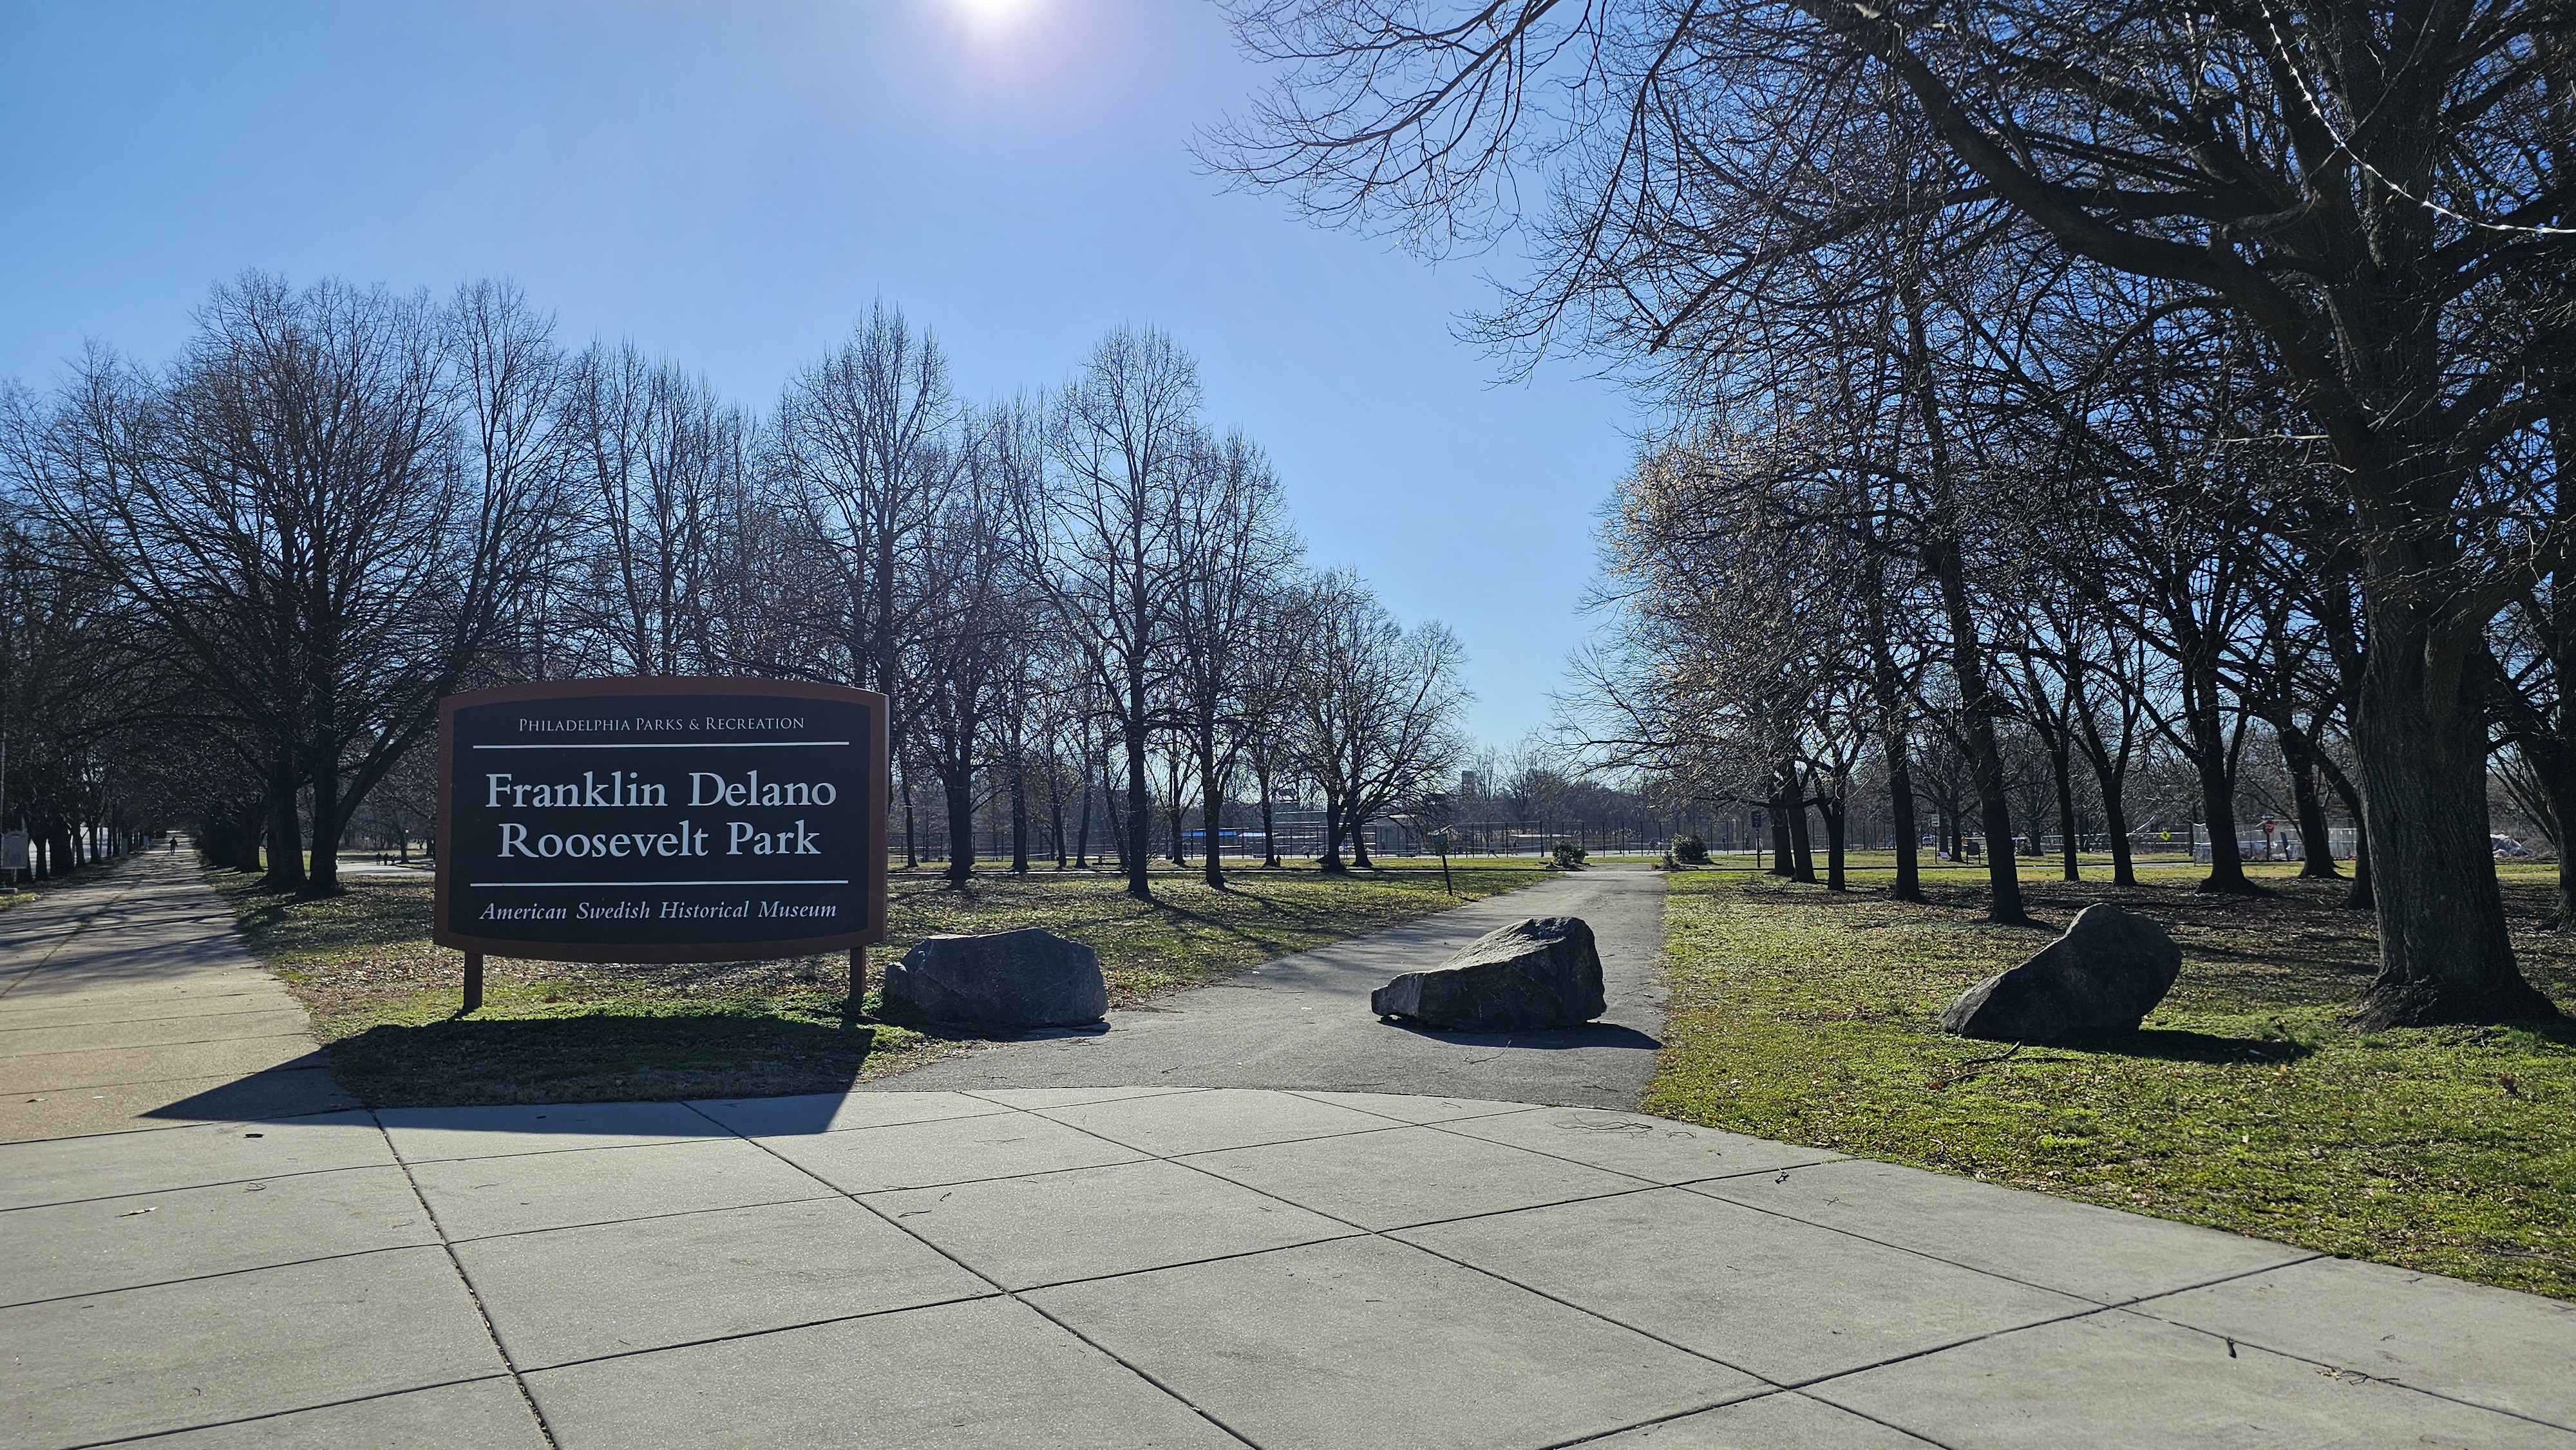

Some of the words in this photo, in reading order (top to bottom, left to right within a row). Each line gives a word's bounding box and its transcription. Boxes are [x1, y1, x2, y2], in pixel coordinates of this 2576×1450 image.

[519, 718, 630, 731] PHILADELPHIA
[636, 717, 683, 731] PARKS
[689, 719, 700, 730] &
[706, 717, 804, 730] RECREATION
[485, 771, 668, 807] Franklin
[687, 770, 837, 807] Delano
[497, 820, 709, 858] Roosevelt
[726, 819, 822, 856] Park
[479, 903, 567, 919] American
[576, 901, 650, 919] Swedish
[658, 900, 750, 918] Historical
[757, 901, 837, 918] Museum
